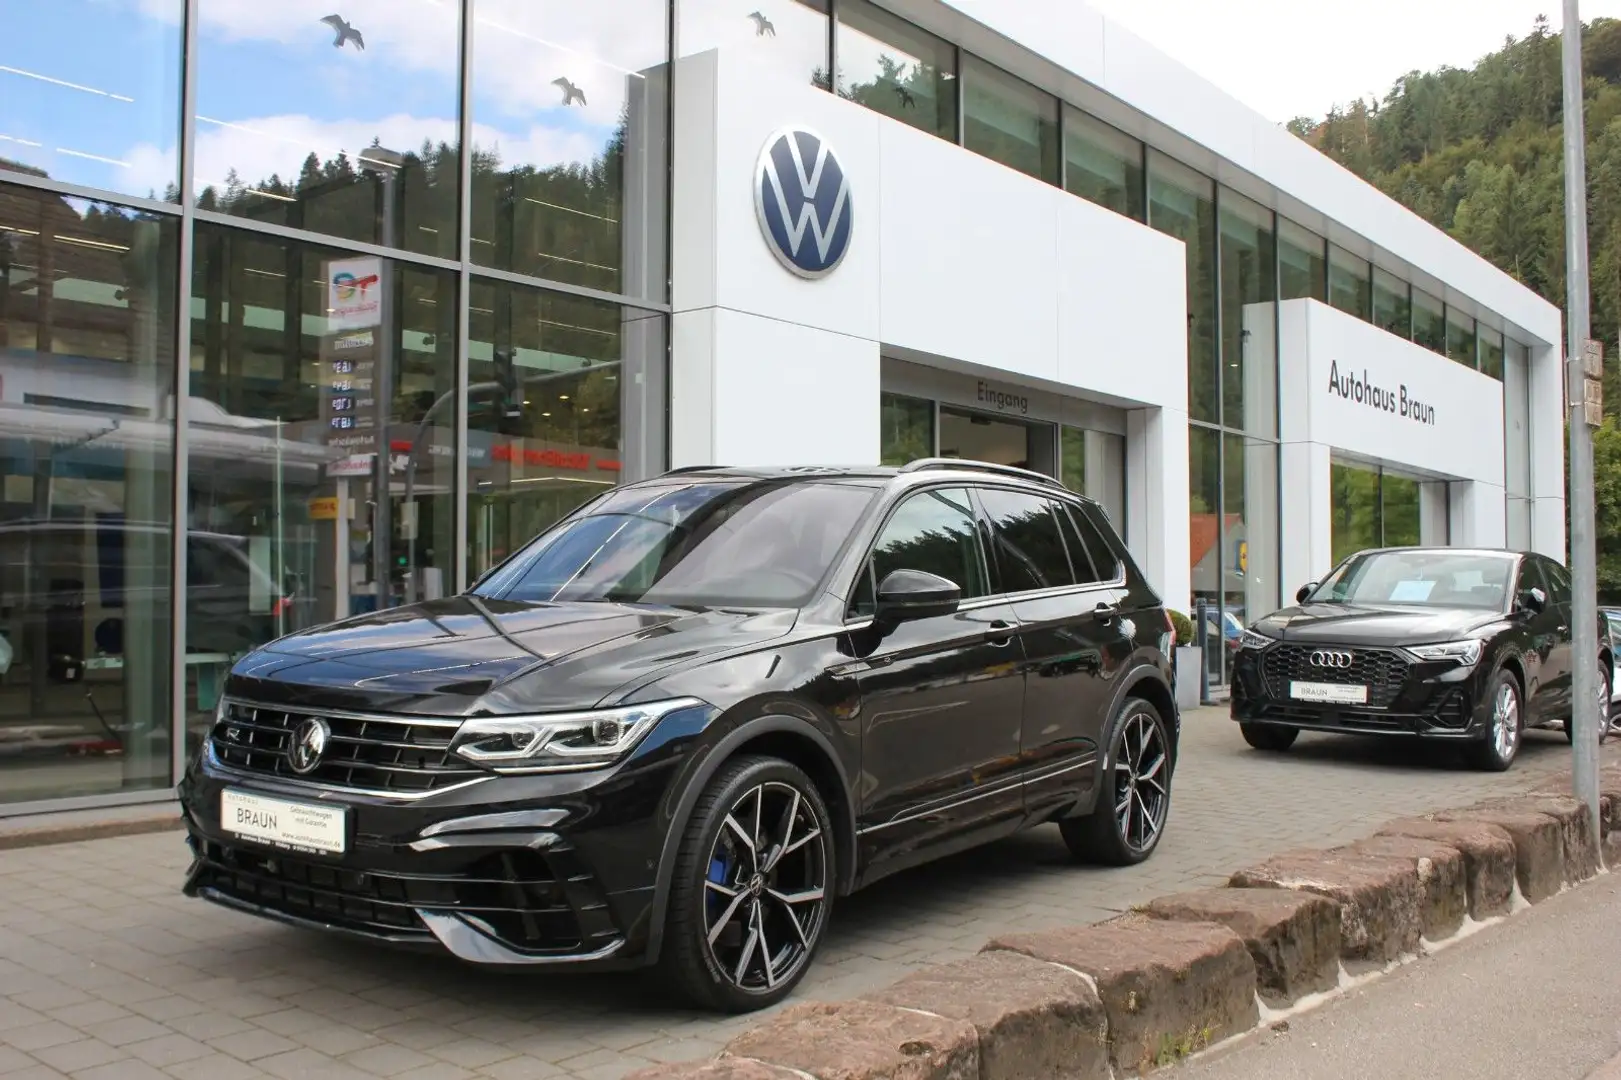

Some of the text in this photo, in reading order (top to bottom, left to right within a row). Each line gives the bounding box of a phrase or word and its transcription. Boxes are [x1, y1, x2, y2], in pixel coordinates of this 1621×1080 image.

[977, 381, 1029, 414] Eingang
[1328, 359, 1436, 426] Autohaus Braun
[1300, 688, 1328, 696] BRAUN
[236, 807, 278, 830] BRAUN
